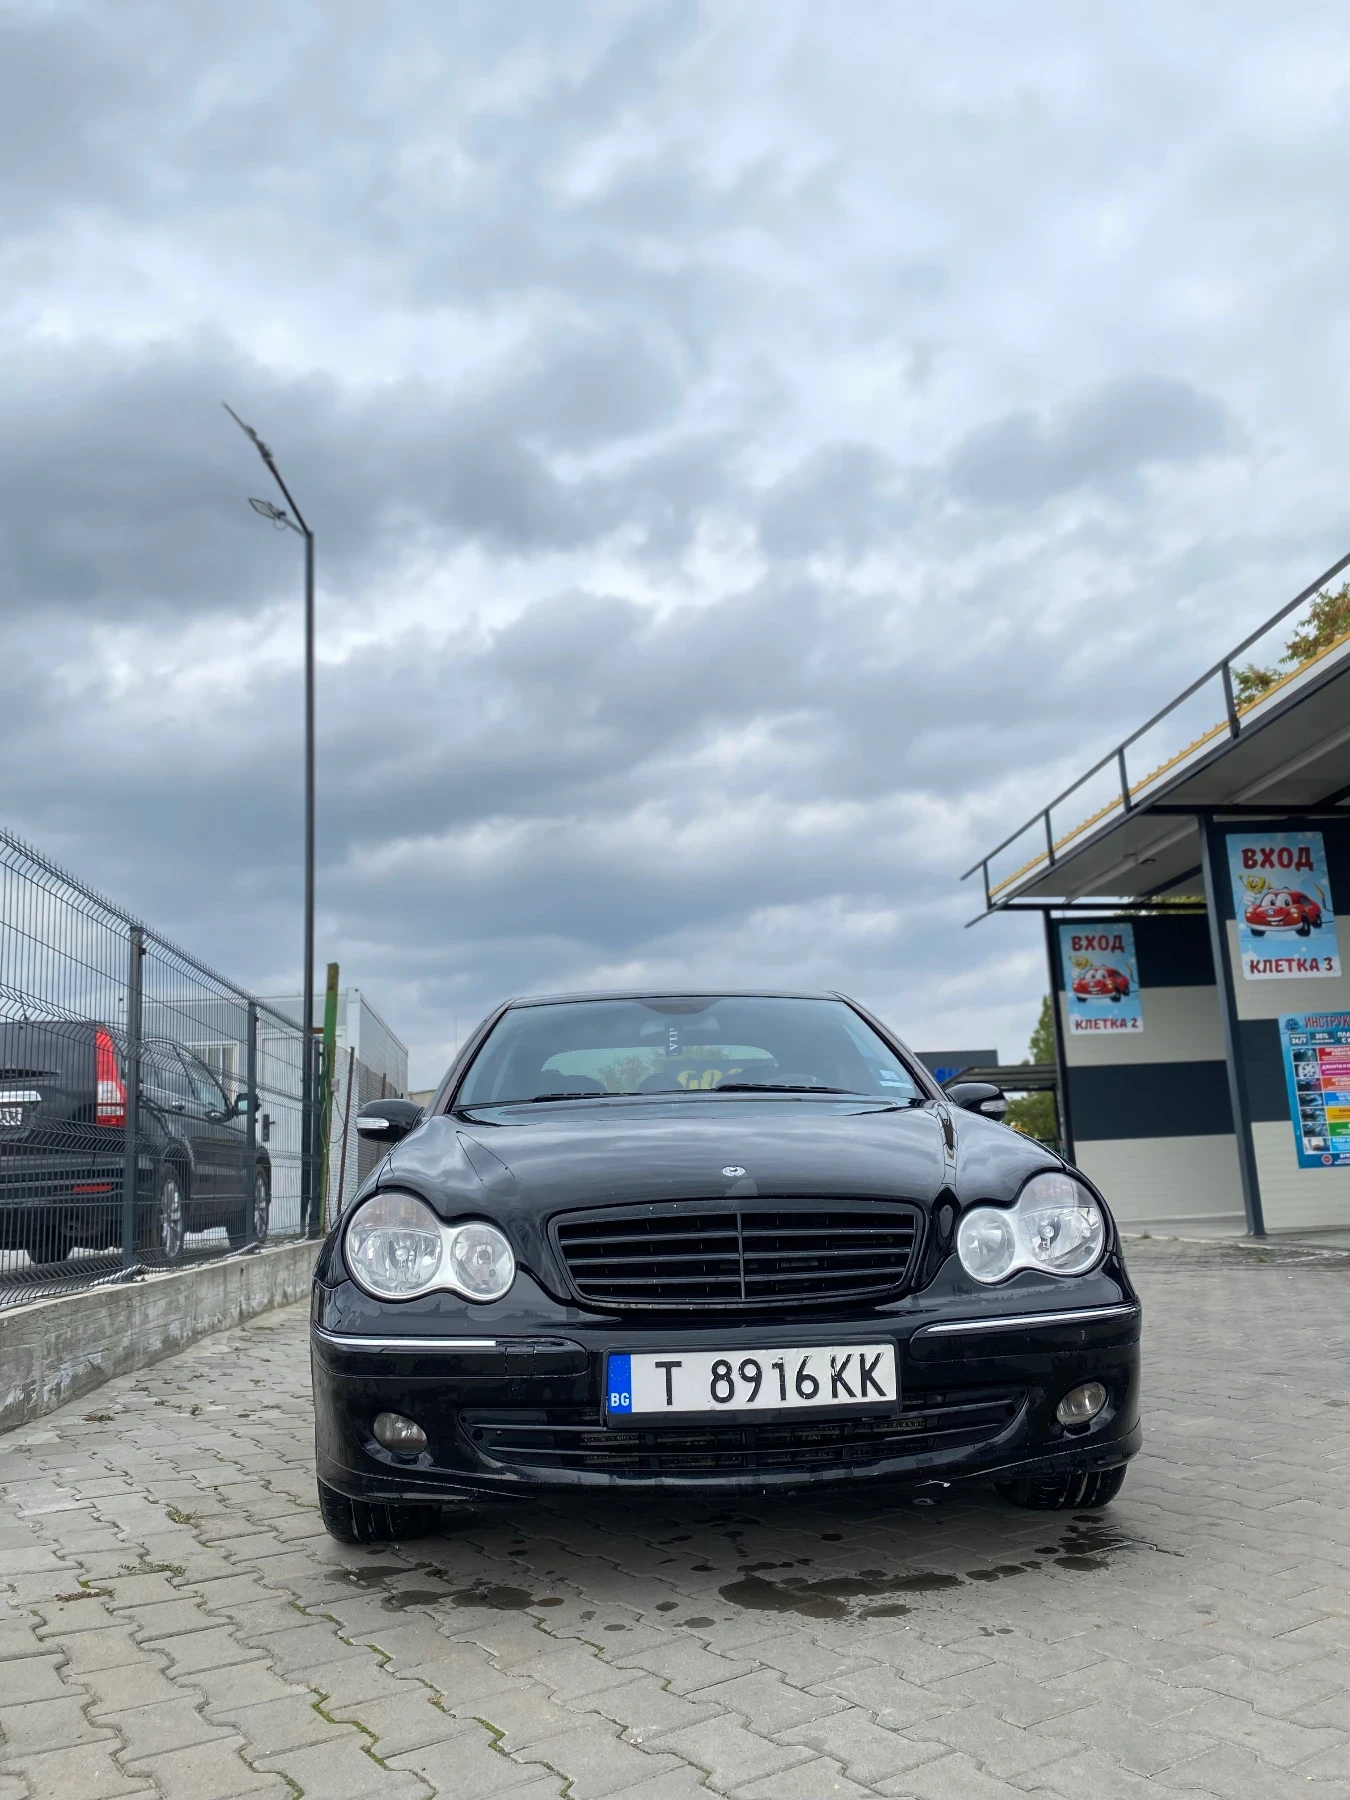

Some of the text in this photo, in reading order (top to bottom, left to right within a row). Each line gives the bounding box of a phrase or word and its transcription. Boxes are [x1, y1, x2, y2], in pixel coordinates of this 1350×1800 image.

[1241, 846, 1314, 872] ВХОД
[1071, 934, 1125, 953] ВХОД
[1250, 956, 1333, 974] КЛЕТКА 3
[1075, 1017, 1139, 1030] КЛЕТКА 2
[669, 1027, 678, 1051] VIP
[655, 1360, 682, 1405] T
[611, 1392, 630, 1407] BG
